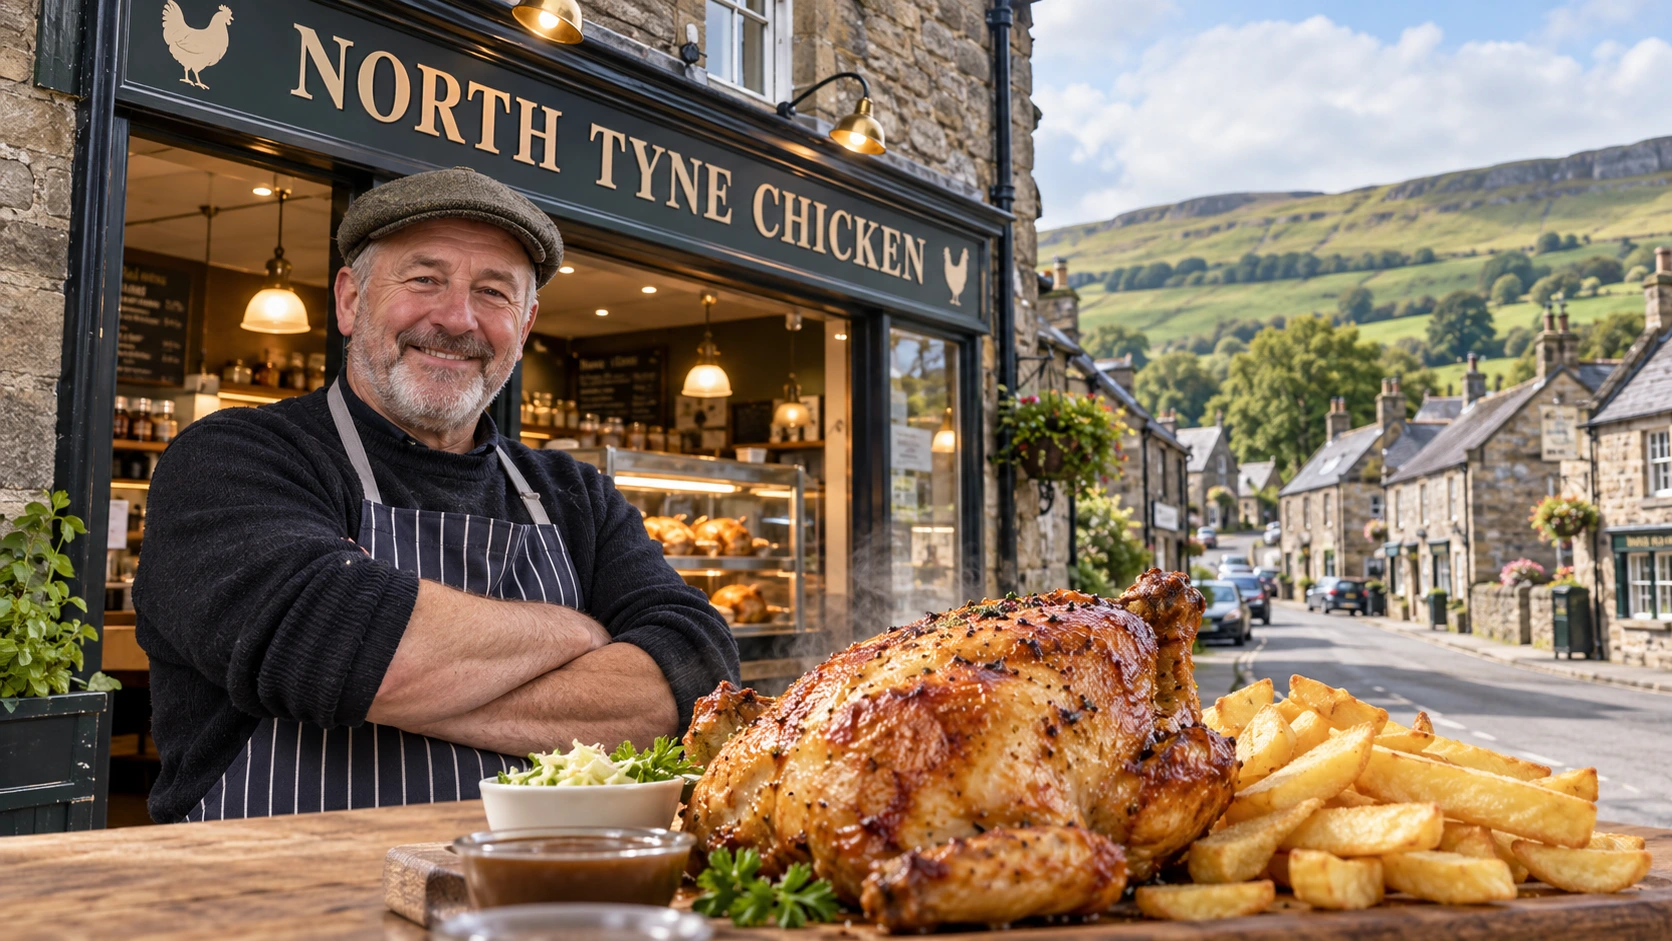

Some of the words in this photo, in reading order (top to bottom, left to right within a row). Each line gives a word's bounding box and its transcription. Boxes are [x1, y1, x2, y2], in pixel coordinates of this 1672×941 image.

[290, 23, 562, 173] NORTH
[590, 122, 732, 225] TYNE
[753, 183, 926, 285] CHICKEN
